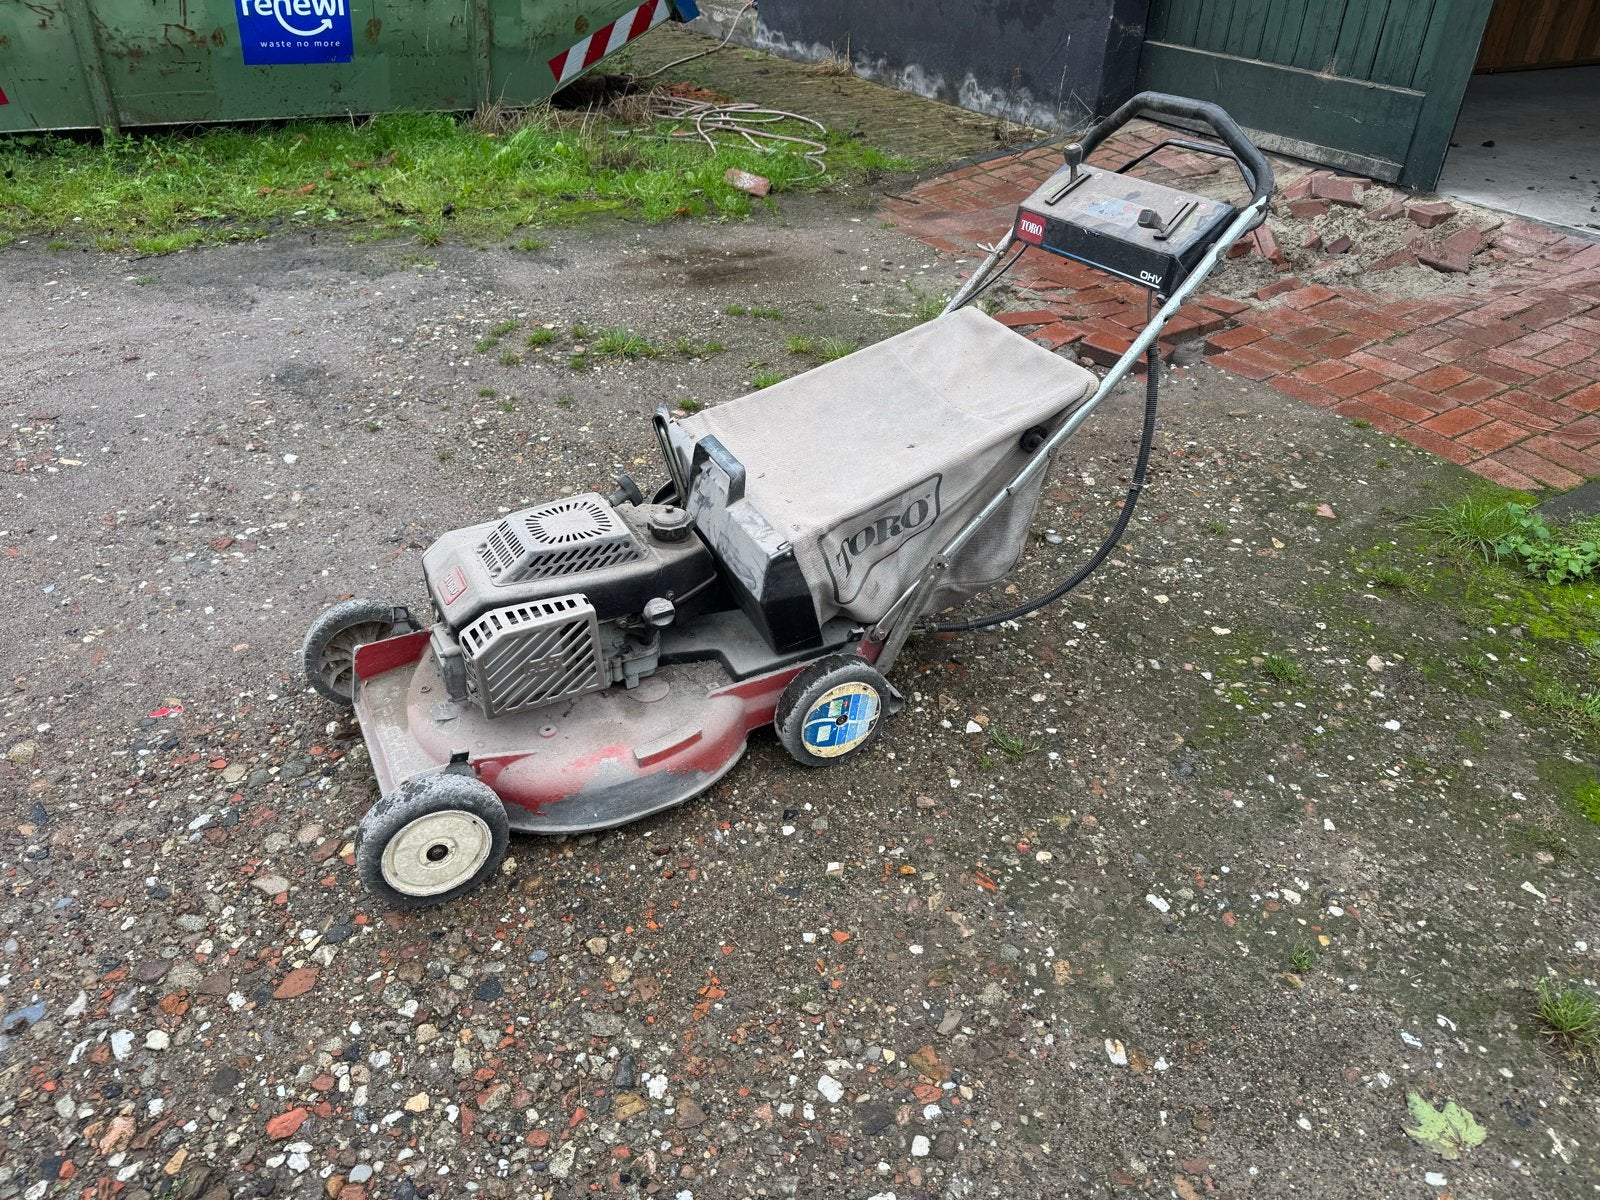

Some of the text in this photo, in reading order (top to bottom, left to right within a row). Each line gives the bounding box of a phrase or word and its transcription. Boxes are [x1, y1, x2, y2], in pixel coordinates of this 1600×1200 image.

[260, 40, 292, 48] waste
[1020, 219, 1043, 236] TORO
[1140, 270, 1162, 284] OHV
[835, 497, 930, 578] TORO
